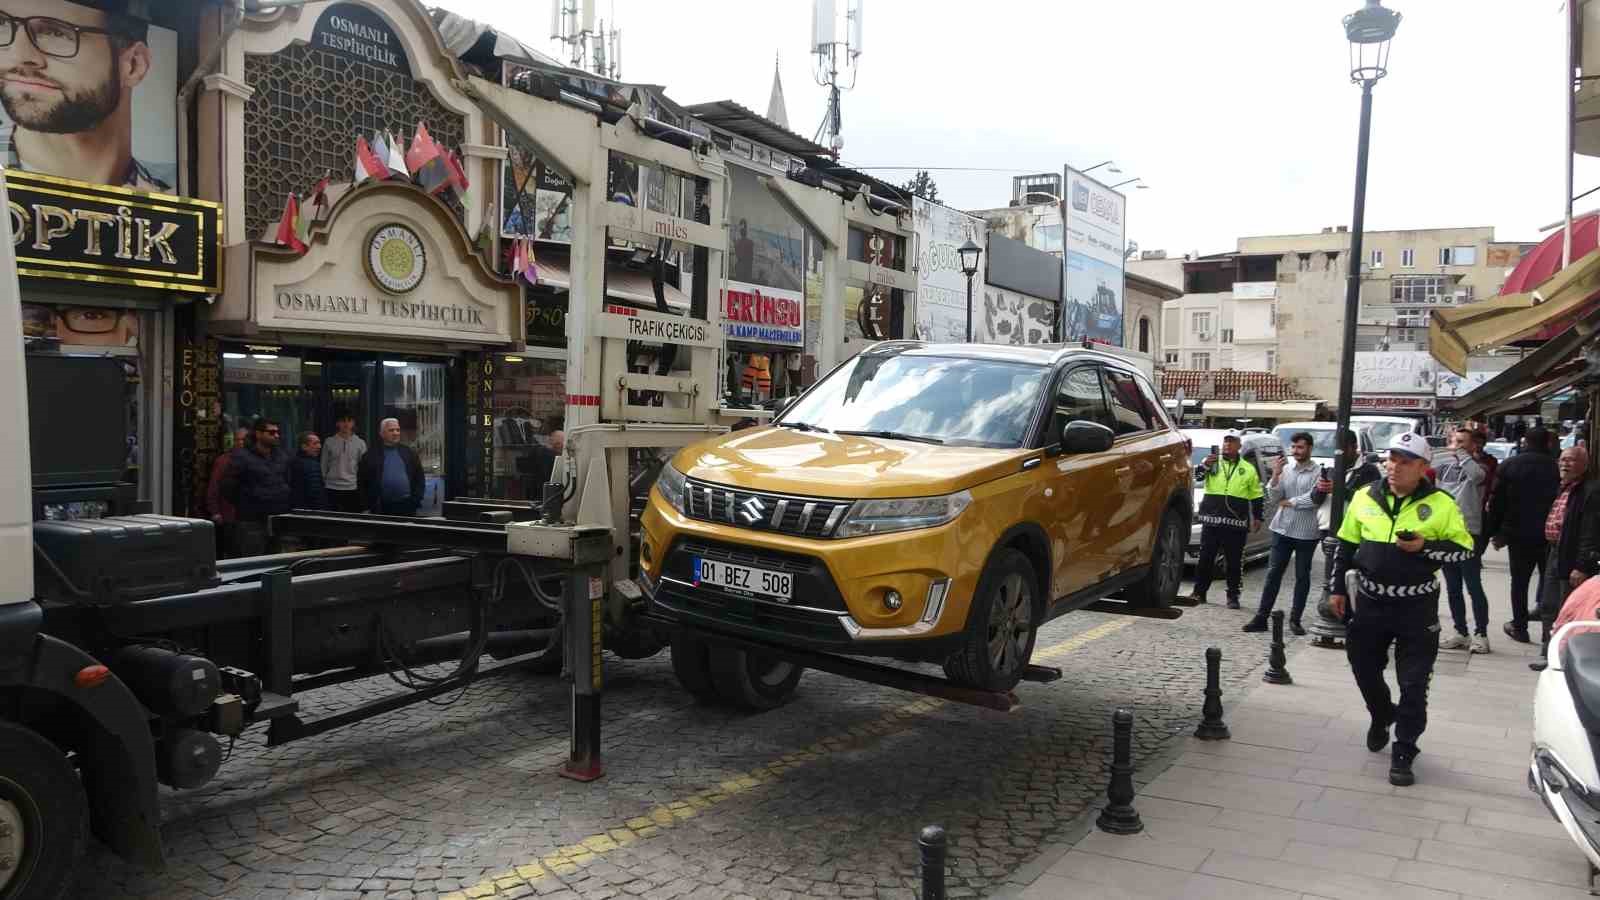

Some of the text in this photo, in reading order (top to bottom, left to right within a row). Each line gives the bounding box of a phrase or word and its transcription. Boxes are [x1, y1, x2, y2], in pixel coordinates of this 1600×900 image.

[330, 15, 388, 45] OSMANLI
[320, 31, 397, 66] TESPİHÇİLİK
[655, 218, 688, 240] miles
[278, 292, 484, 327] OSMANLI TESPİHÇİLİK
[719, 288, 801, 327] ERİNSU
[736, 324, 757, 338] KAMP
[180, 348, 193, 427] EKOL
[702, 562, 716, 582] 01
[725, 566, 751, 589] BEZ
[762, 573, 790, 595] 508
